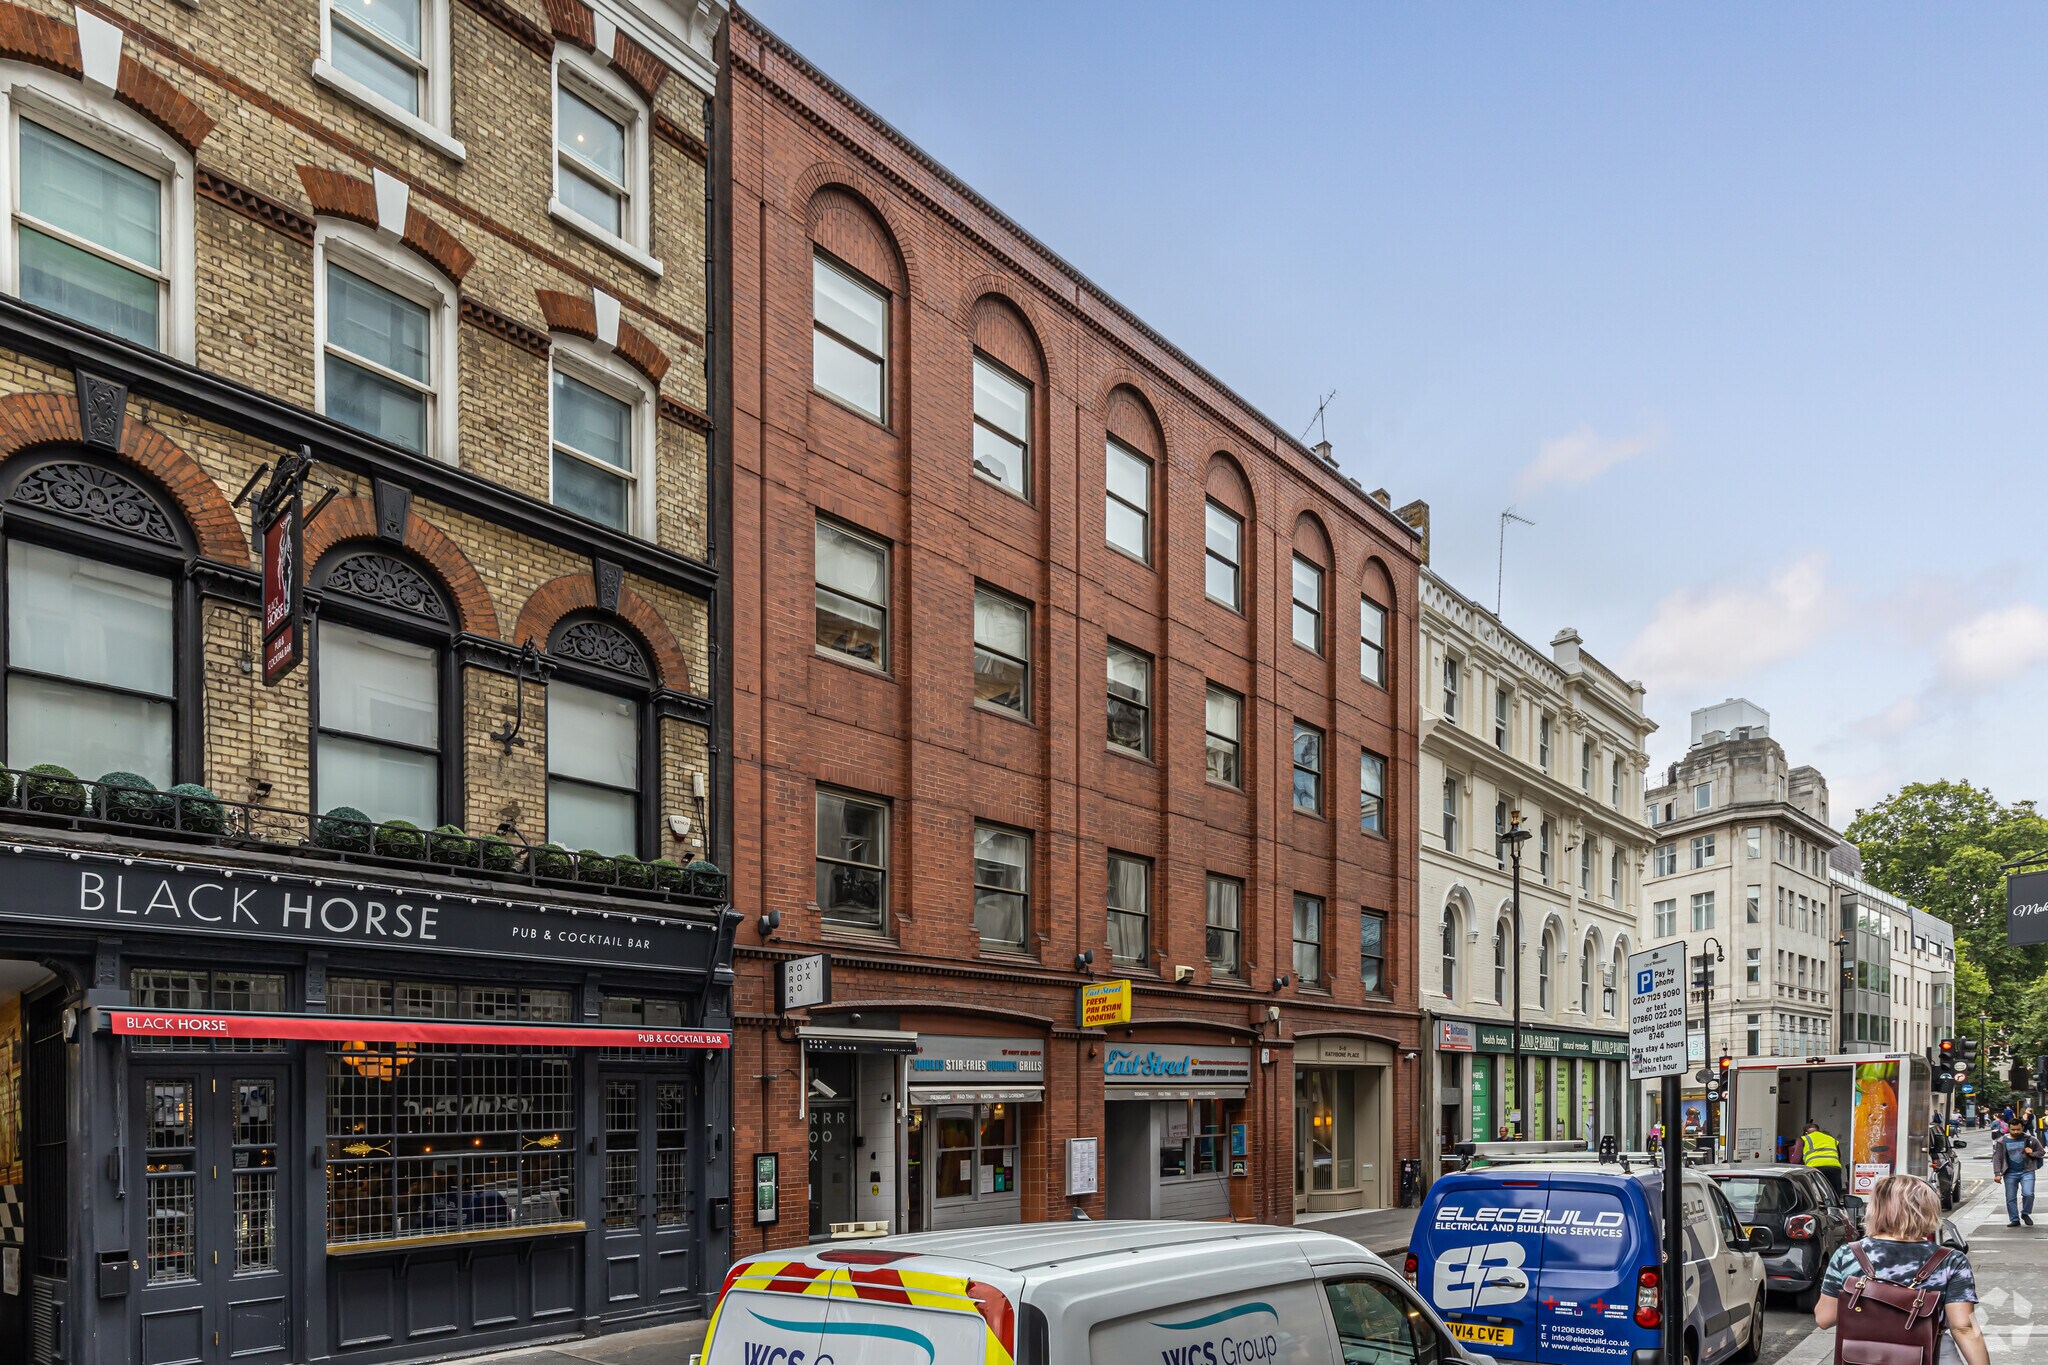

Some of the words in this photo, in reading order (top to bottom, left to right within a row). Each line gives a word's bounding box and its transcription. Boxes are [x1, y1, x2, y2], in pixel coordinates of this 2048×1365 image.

[267, 596, 279, 612] BLACK
[267, 603, 284, 629] HORSE
[267, 650, 284, 670] COCKTAIL
[284, 642, 292, 656] BAR
[80, 872, 259, 925] BLACK
[282, 892, 439, 940] HORSE
[512, 927, 537, 939] PUB
[543, 930, 551, 941] &
[558, 931, 622, 947] COCKTAIL
[627, 938, 650, 949] BAR
[788, 960, 818, 973] ROXY
[788, 972, 810, 984] ROX
[1654, 970, 1665, 979] Pay
[1667, 968, 1675, 976] by
[1641, 972, 1651, 992] P
[1655, 977, 1674, 989] phone
[788, 984, 802, 994] RO
[1086, 988, 1100, 997] East
[788, 996, 794, 1004] R
[1086, 997, 1108, 1006] FRESH
[1632, 995, 1645, 1005] 020
[1647, 992, 1661, 1002] 7125
[1663, 988, 1681, 998] 9090
[1086, 1006, 1100, 1014] PAN
[1101, 1003, 1122, 1012] ASIAN
[1654, 1002, 1667, 1011] text
[1086, 1012, 1116, 1022] COOKING
[1654, 1010, 1667, 1020] 022
[1668, 1008, 1682, 1017] 205
[126, 1017, 174, 1031] BLACK
[178, 1018, 226, 1032] HORSE
[1632, 1024, 1656, 1036] quoting
[1656, 1020, 1682, 1031] location
[638, 1034, 654, 1043] PUB
[656, 1034, 662, 1043] &
[664, 1034, 705, 1044] COCKTAIL
[706, 1035, 722, 1044] BAR
[1482, 1034, 1495, 1045] health
[1496, 1036, 1508, 1046] foods
[1648, 1031, 1665, 1041] 8746
[1540, 1036, 1560, 1051] BARRETT
[1562, 1041, 1574, 1050] natural
[1575, 1042, 1590, 1051] remedies
[1592, 1040, 1609, 1054] HOLLAND
[1632, 1046, 1644, 1055] Max
[1646, 1043, 1658, 1052] stay
[1660, 1042, 1664, 1050] 4
[1666, 1040, 1684, 1049] hours
[1104, 1050, 1140, 1076] East
[1141, 1051, 1190, 1076] Street
[1642, 1056, 1652, 1064] No
[1652, 1054, 1672, 1062] return
[946, 1060, 986, 1071] STIR-FRIES
[1020, 1061, 1042, 1072] GRILLS
[1662, 1062, 1678, 1071] hour
[1436, 1206, 1624, 1228] ELECBUILD
[1434, 1222, 1492, 1232] ELECTRICAL
[1493, 1223, 1515, 1233] AND
[1516, 1224, 1567, 1235] BUILDING
[1570, 1227, 1623, 1238] SERVICES
[1478, 1327, 1504, 1342] CVE
[1552, 1334, 1630, 1347] info@elecbuild.co.uk
[1161, 1341, 1218, 1365] WCS
[1221, 1334, 1277, 1365] Group
[1551, 1343, 1628, 1356] www.elecbuild.co.uk
